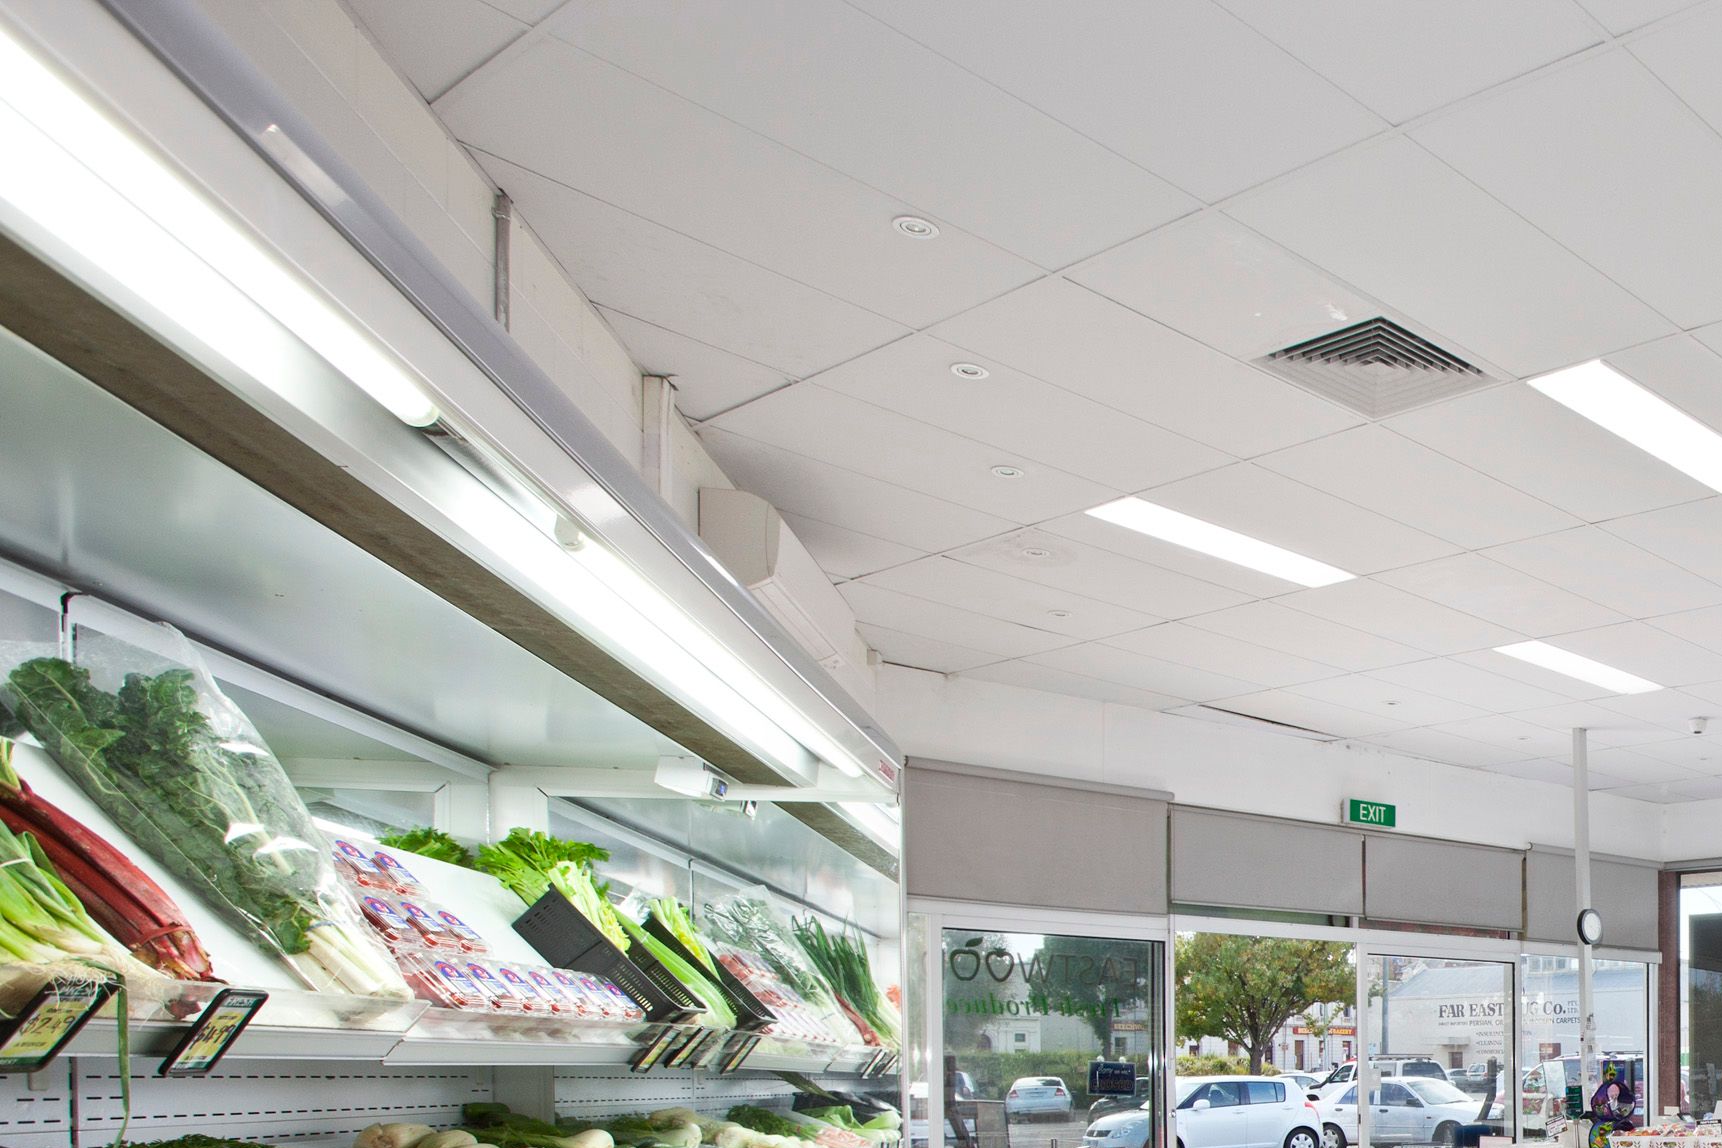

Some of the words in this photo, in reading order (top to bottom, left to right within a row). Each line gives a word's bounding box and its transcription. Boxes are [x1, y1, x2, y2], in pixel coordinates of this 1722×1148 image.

[1360, 804, 1386, 823] EXIT
[1438, 1003, 1465, 1018] FAR
[1469, 1002, 1505, 1017] EAST
[1543, 1000, 1566, 1015] Co.
[1556, 1016, 1580, 1024] CARPETS
